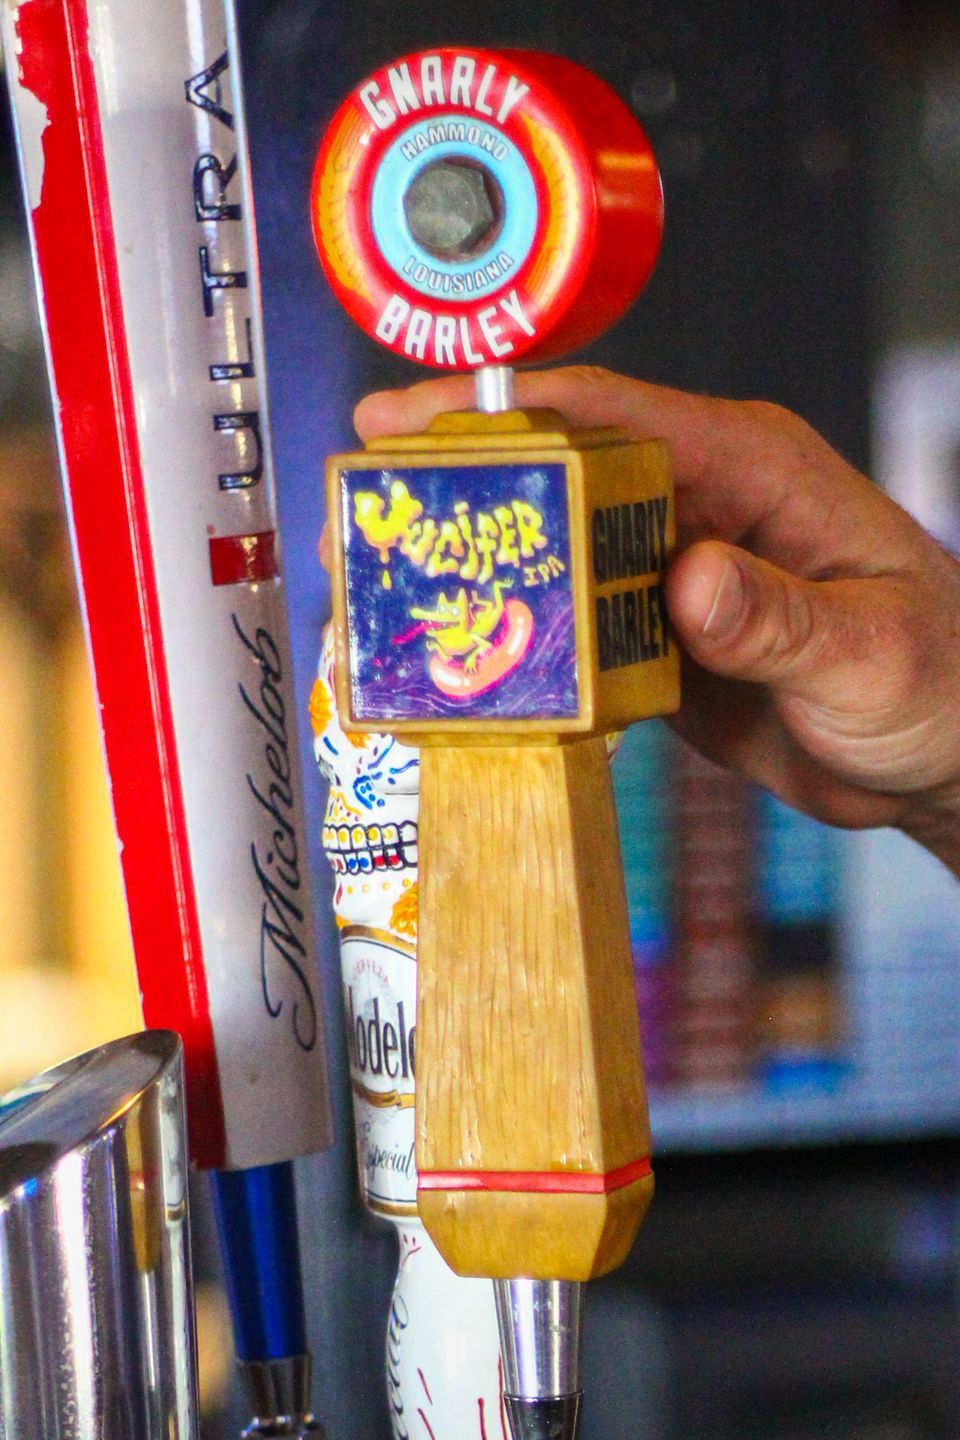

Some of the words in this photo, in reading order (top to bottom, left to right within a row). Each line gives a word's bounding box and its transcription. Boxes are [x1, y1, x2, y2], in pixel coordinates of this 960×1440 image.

[359, 55, 531, 131] GNARLY
[401, 122, 508, 161] HAMMOND
[185, 48, 263, 490] ULTRA
[402, 250, 516, 293] LOUISIANA
[374, 289, 537, 366] BARLEY
[523, 554, 566, 587] IPA
[231, 612, 318, 1052] Michelob
